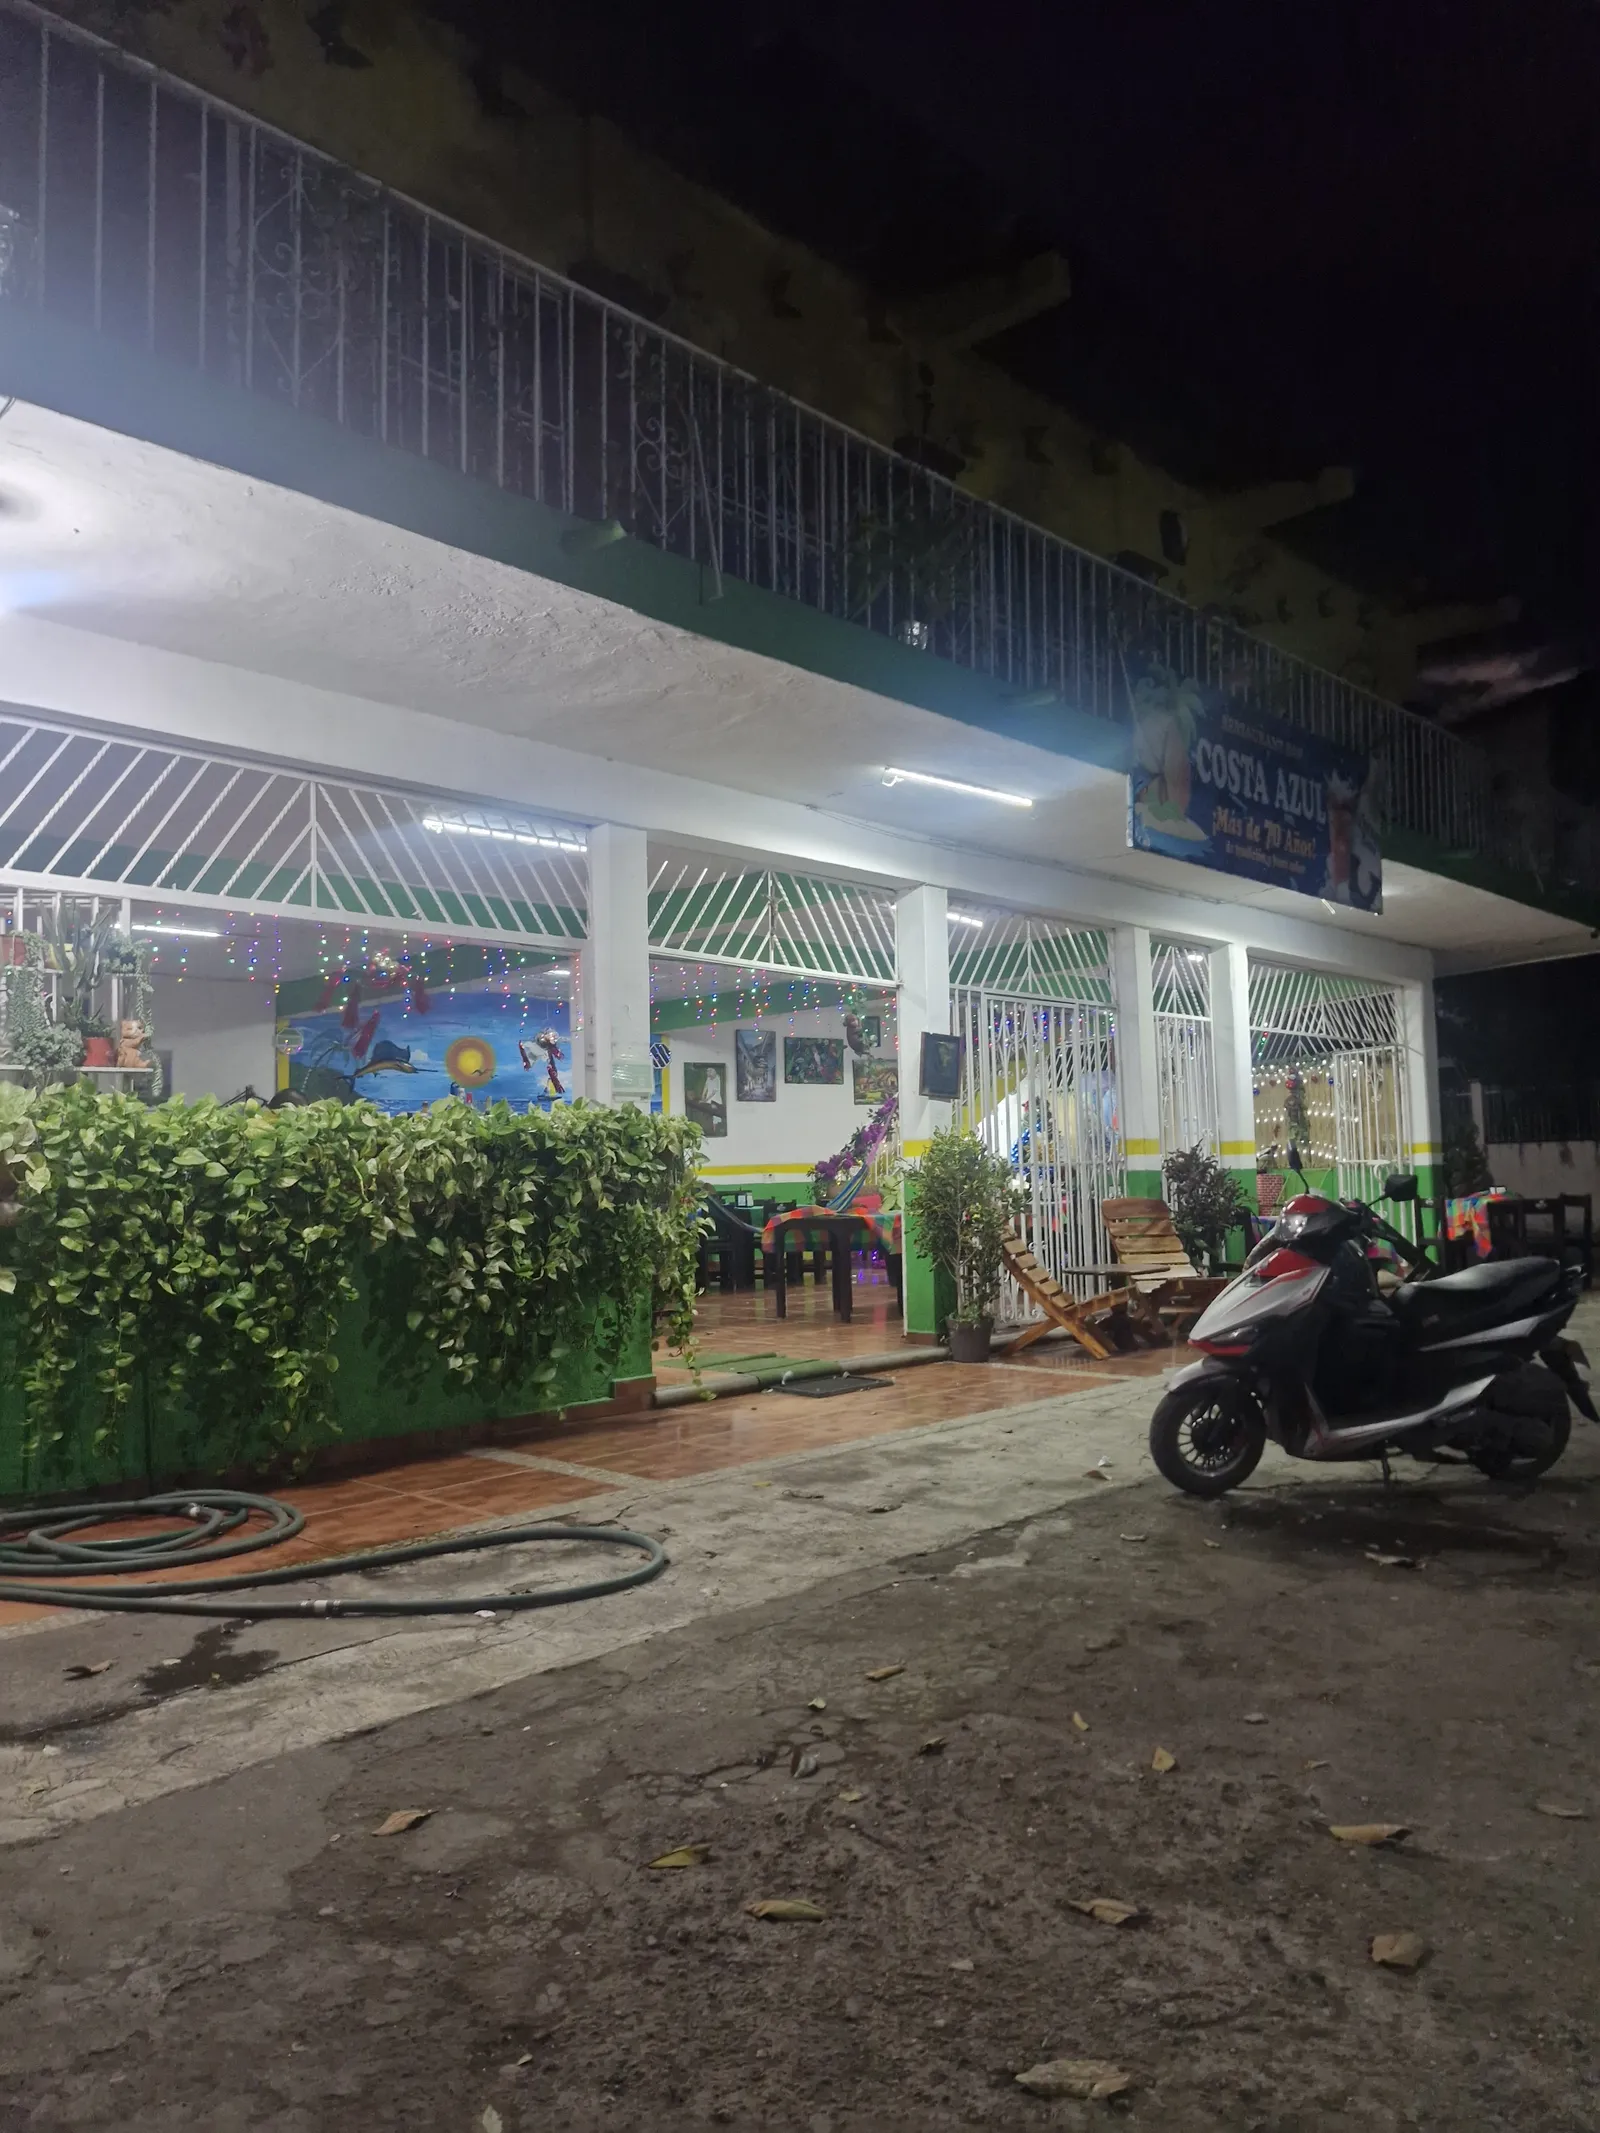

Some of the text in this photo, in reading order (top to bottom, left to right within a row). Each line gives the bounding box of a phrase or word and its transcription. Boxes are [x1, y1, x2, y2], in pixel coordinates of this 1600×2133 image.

[1196, 737, 1327, 825] COSTA AZUL
[1246, 815, 1261, 843] de
